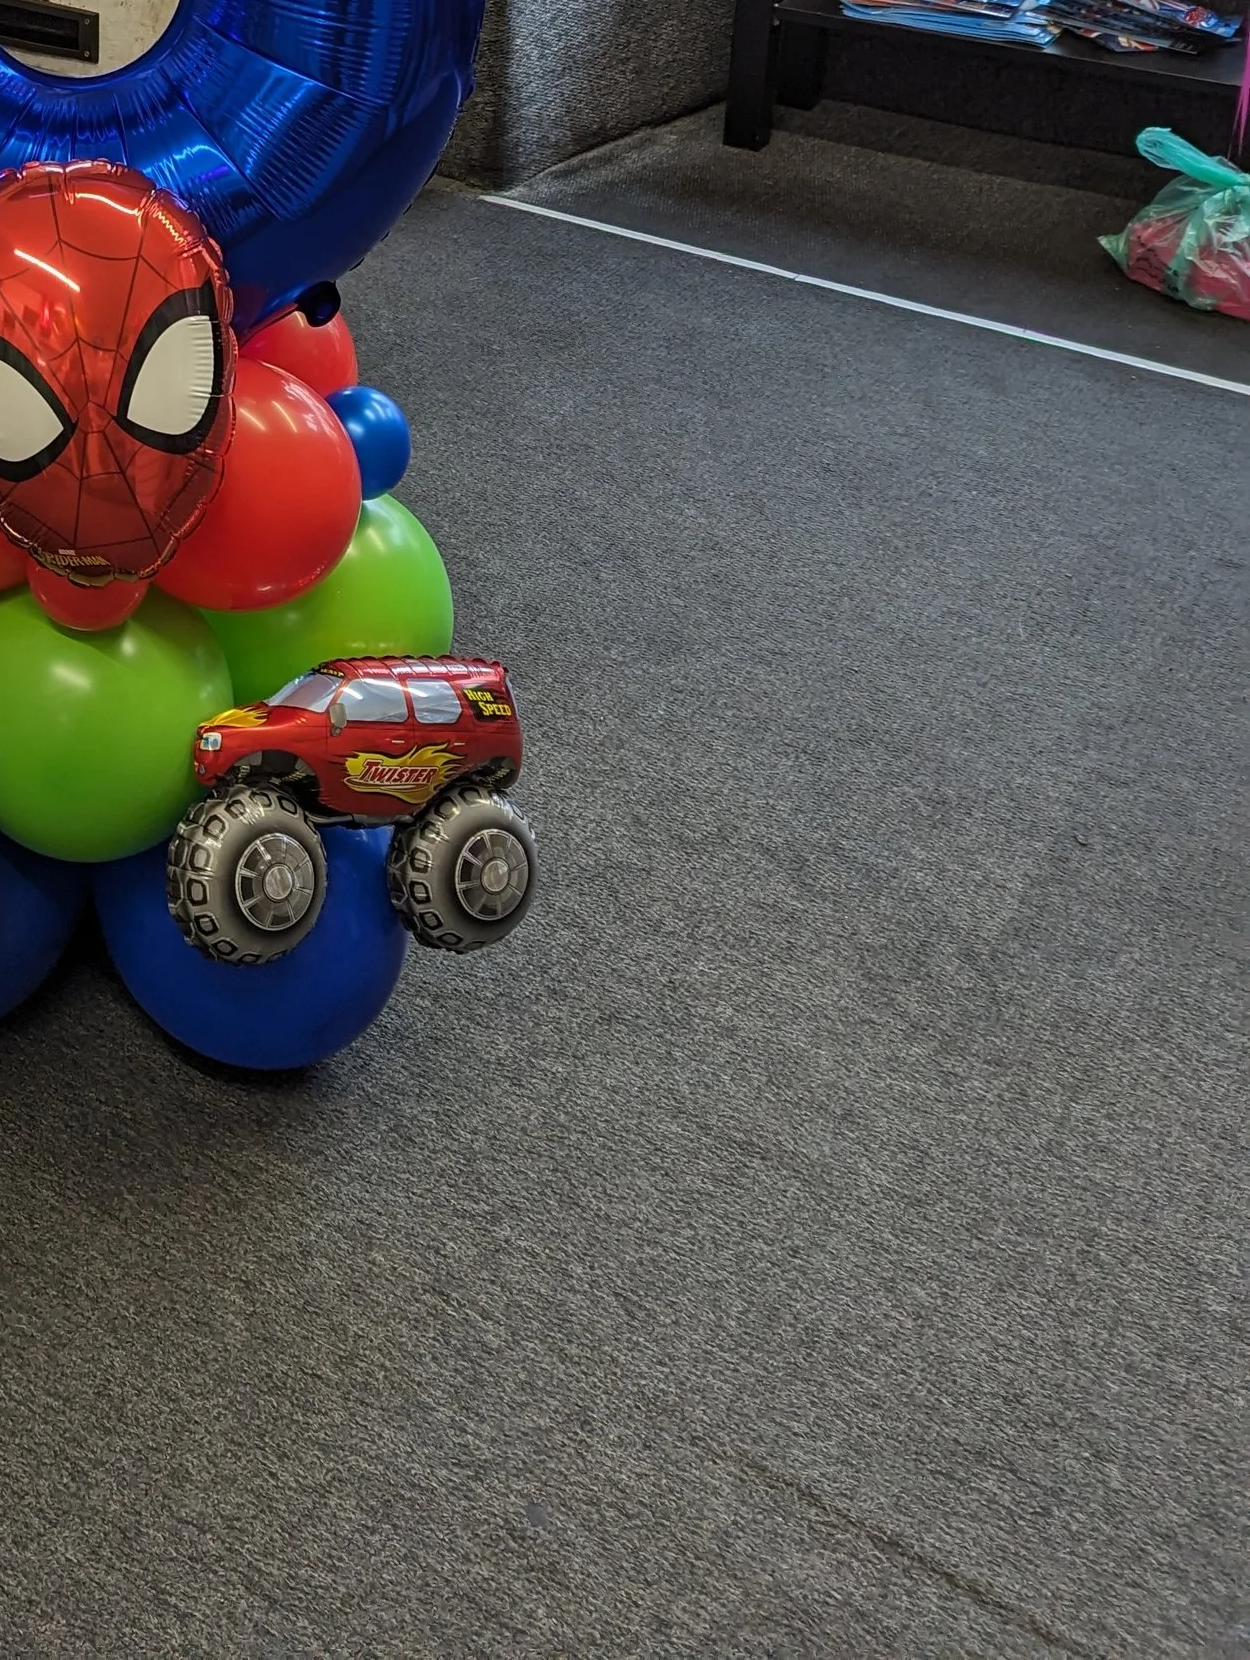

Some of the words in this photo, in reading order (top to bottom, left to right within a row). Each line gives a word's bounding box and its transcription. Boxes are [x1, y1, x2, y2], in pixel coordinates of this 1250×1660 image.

[465, 688, 493, 703] HIGH
[479, 702, 512, 717] SPEED
[360, 760, 439, 785] TWISTER
